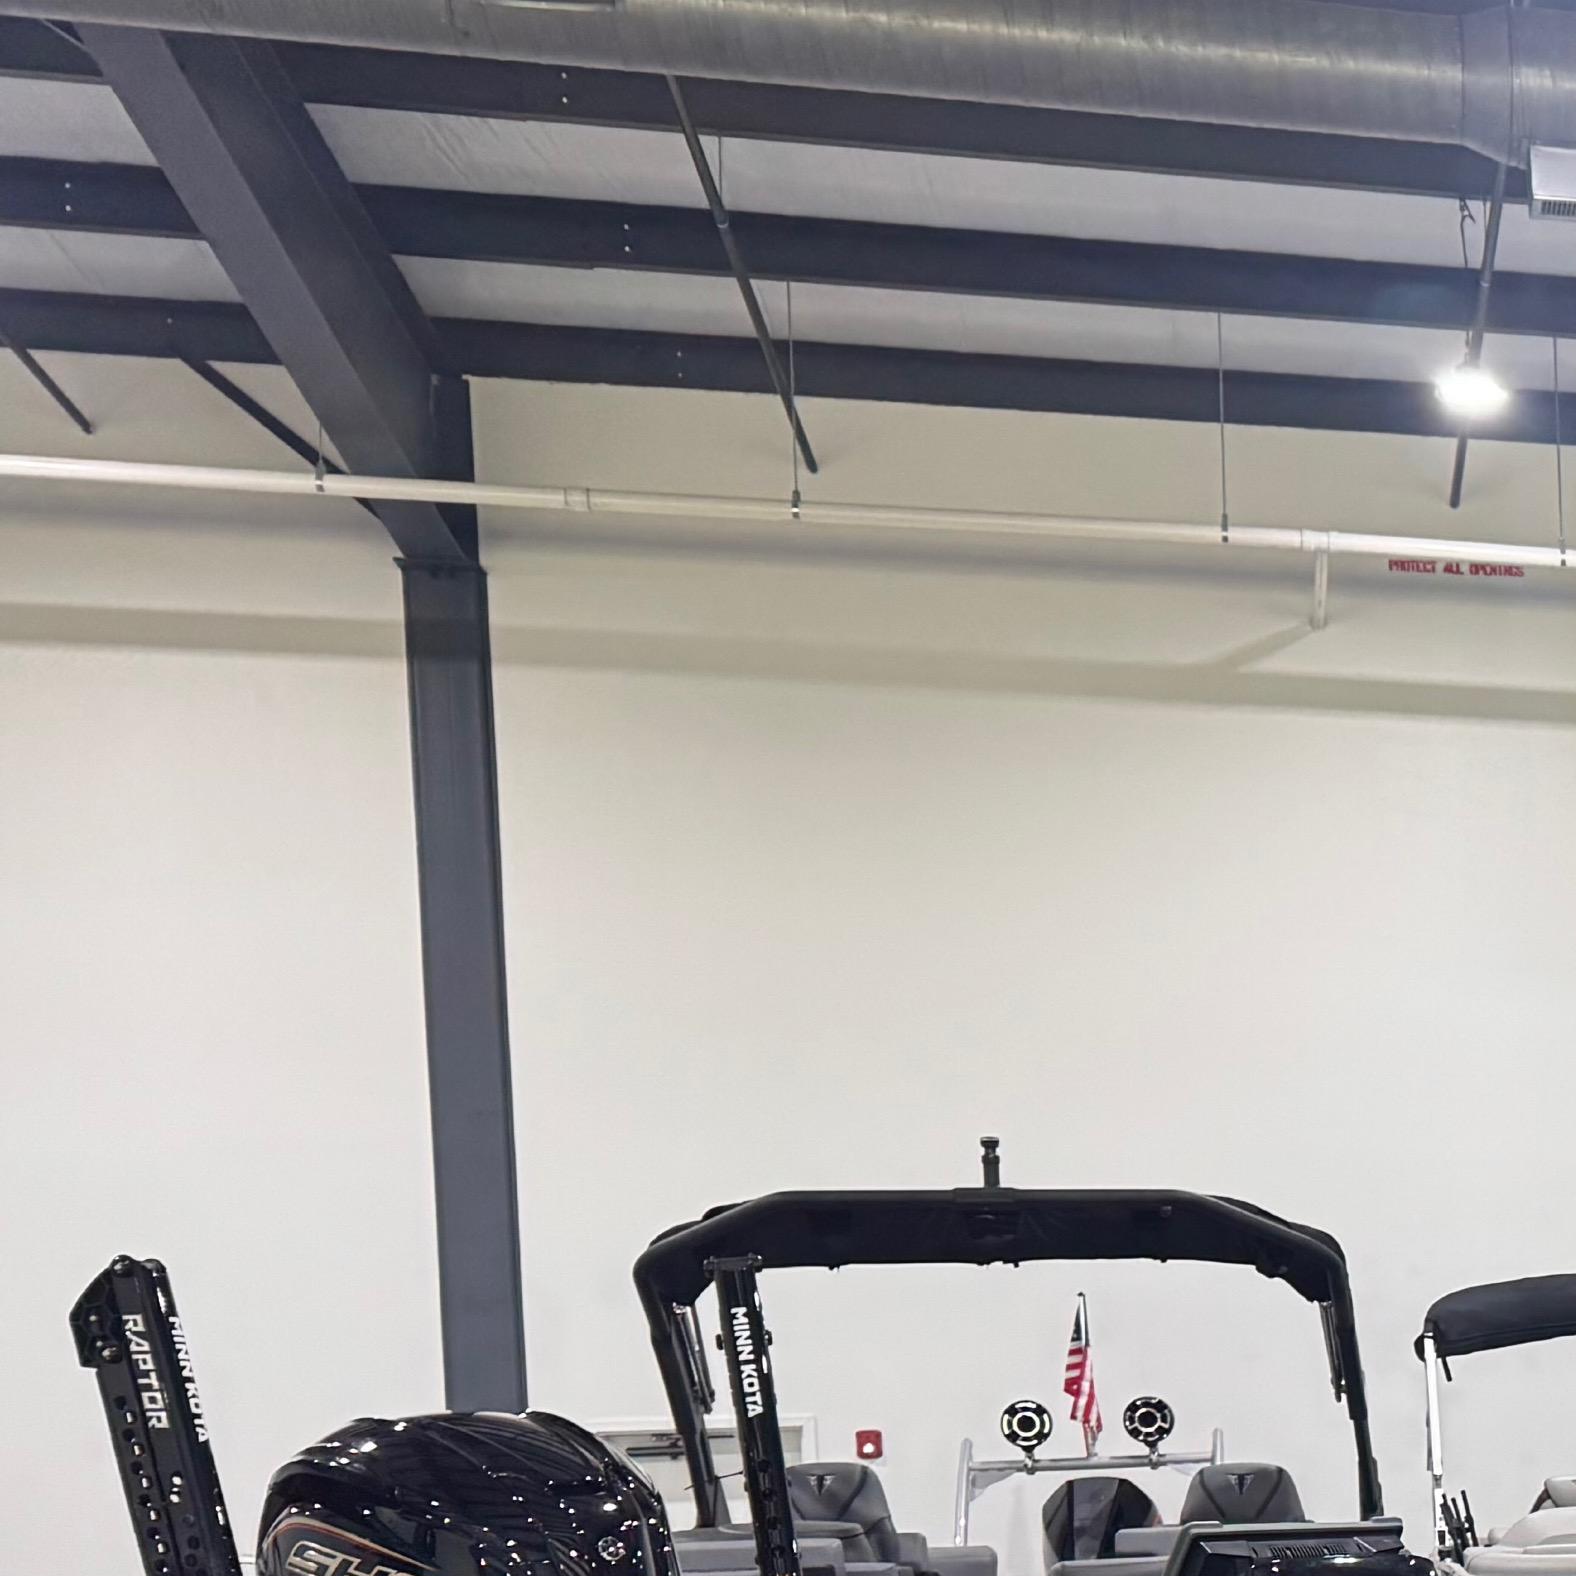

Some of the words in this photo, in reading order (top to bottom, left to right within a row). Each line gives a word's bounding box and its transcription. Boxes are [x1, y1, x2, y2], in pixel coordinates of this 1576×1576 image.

[121, 1313, 170, 1429] RAPTOR
[730, 1306, 755, 1361] MINN
[168, 1315, 195, 1378] MINN
[184, 1381, 210, 1443] KOTA
[740, 1364, 764, 1418] KOTA
